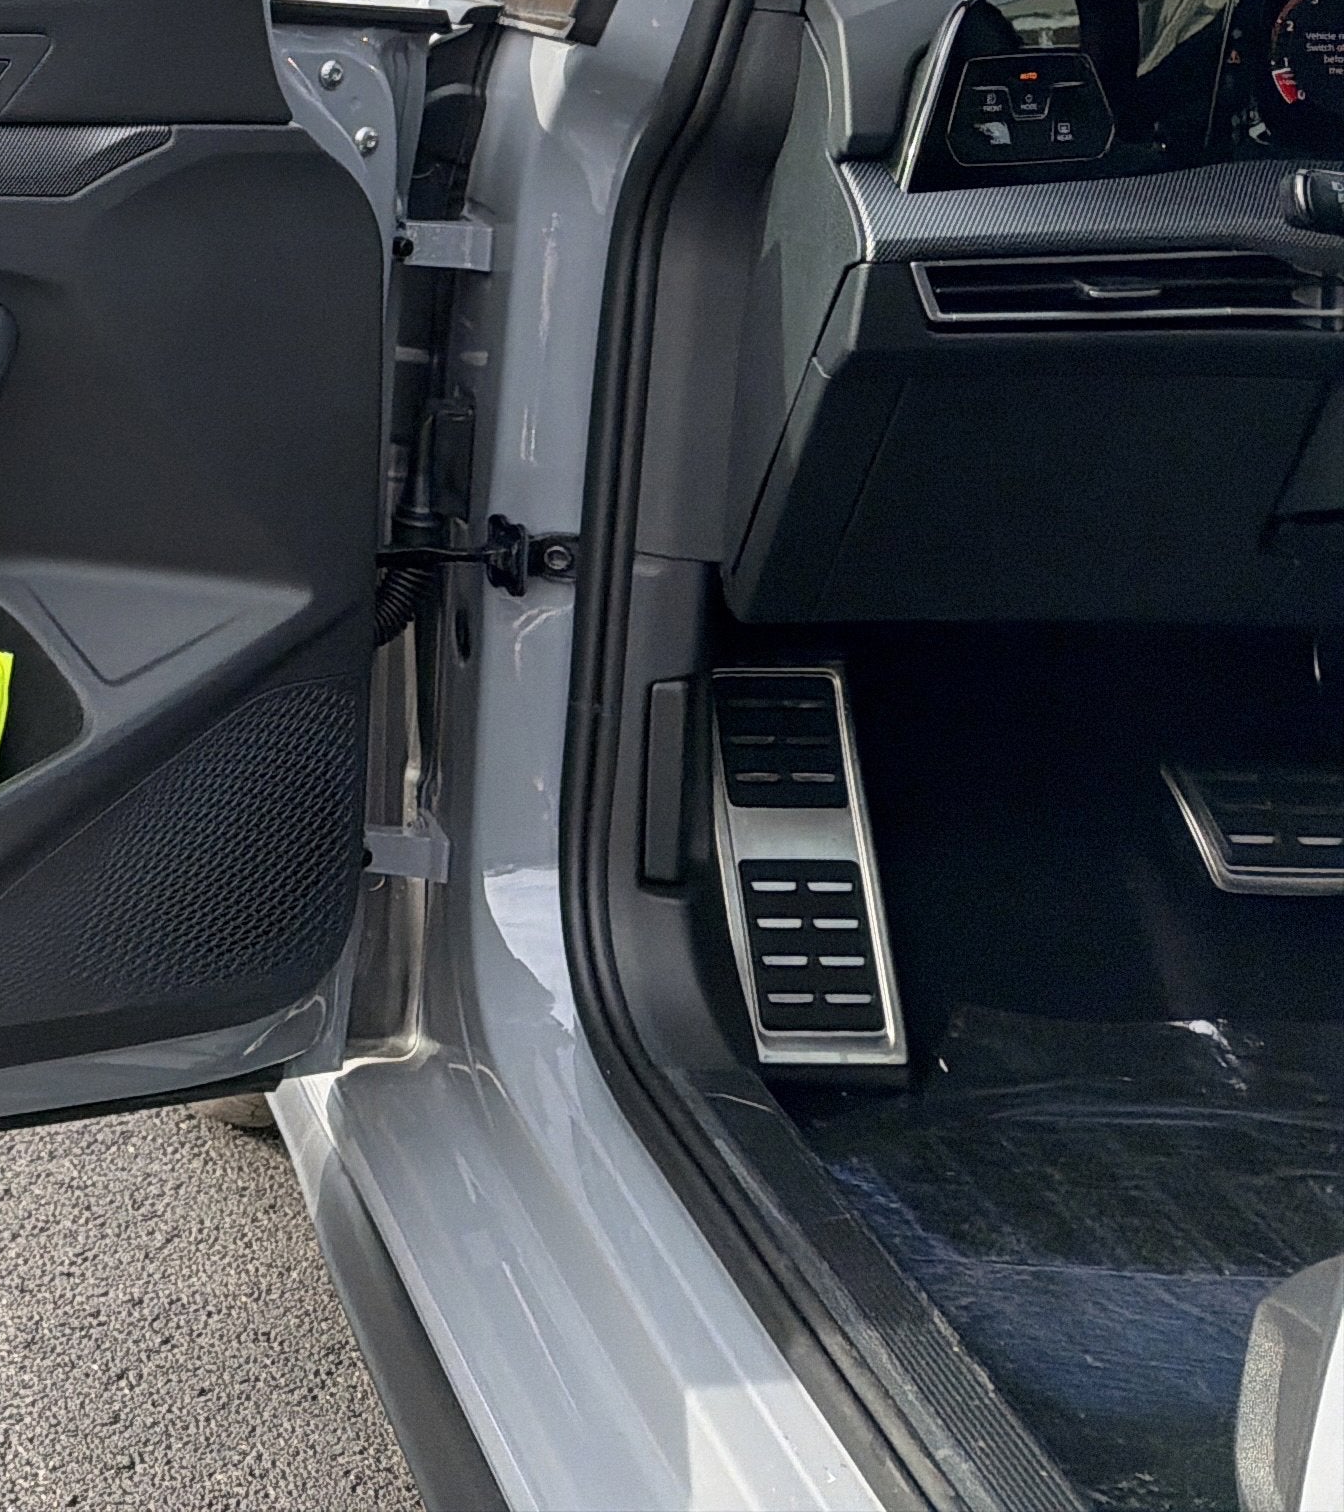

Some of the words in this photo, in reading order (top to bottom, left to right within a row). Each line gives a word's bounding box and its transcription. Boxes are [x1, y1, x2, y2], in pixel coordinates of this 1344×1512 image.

[1286, 21, 1294, 32] 2
[1306, 43, 1335, 52] Switch
[1283, 57, 1289, 67] 1
[1324, 55, 1344, 64] befo
[1297, 89, 1306, 101] 0
